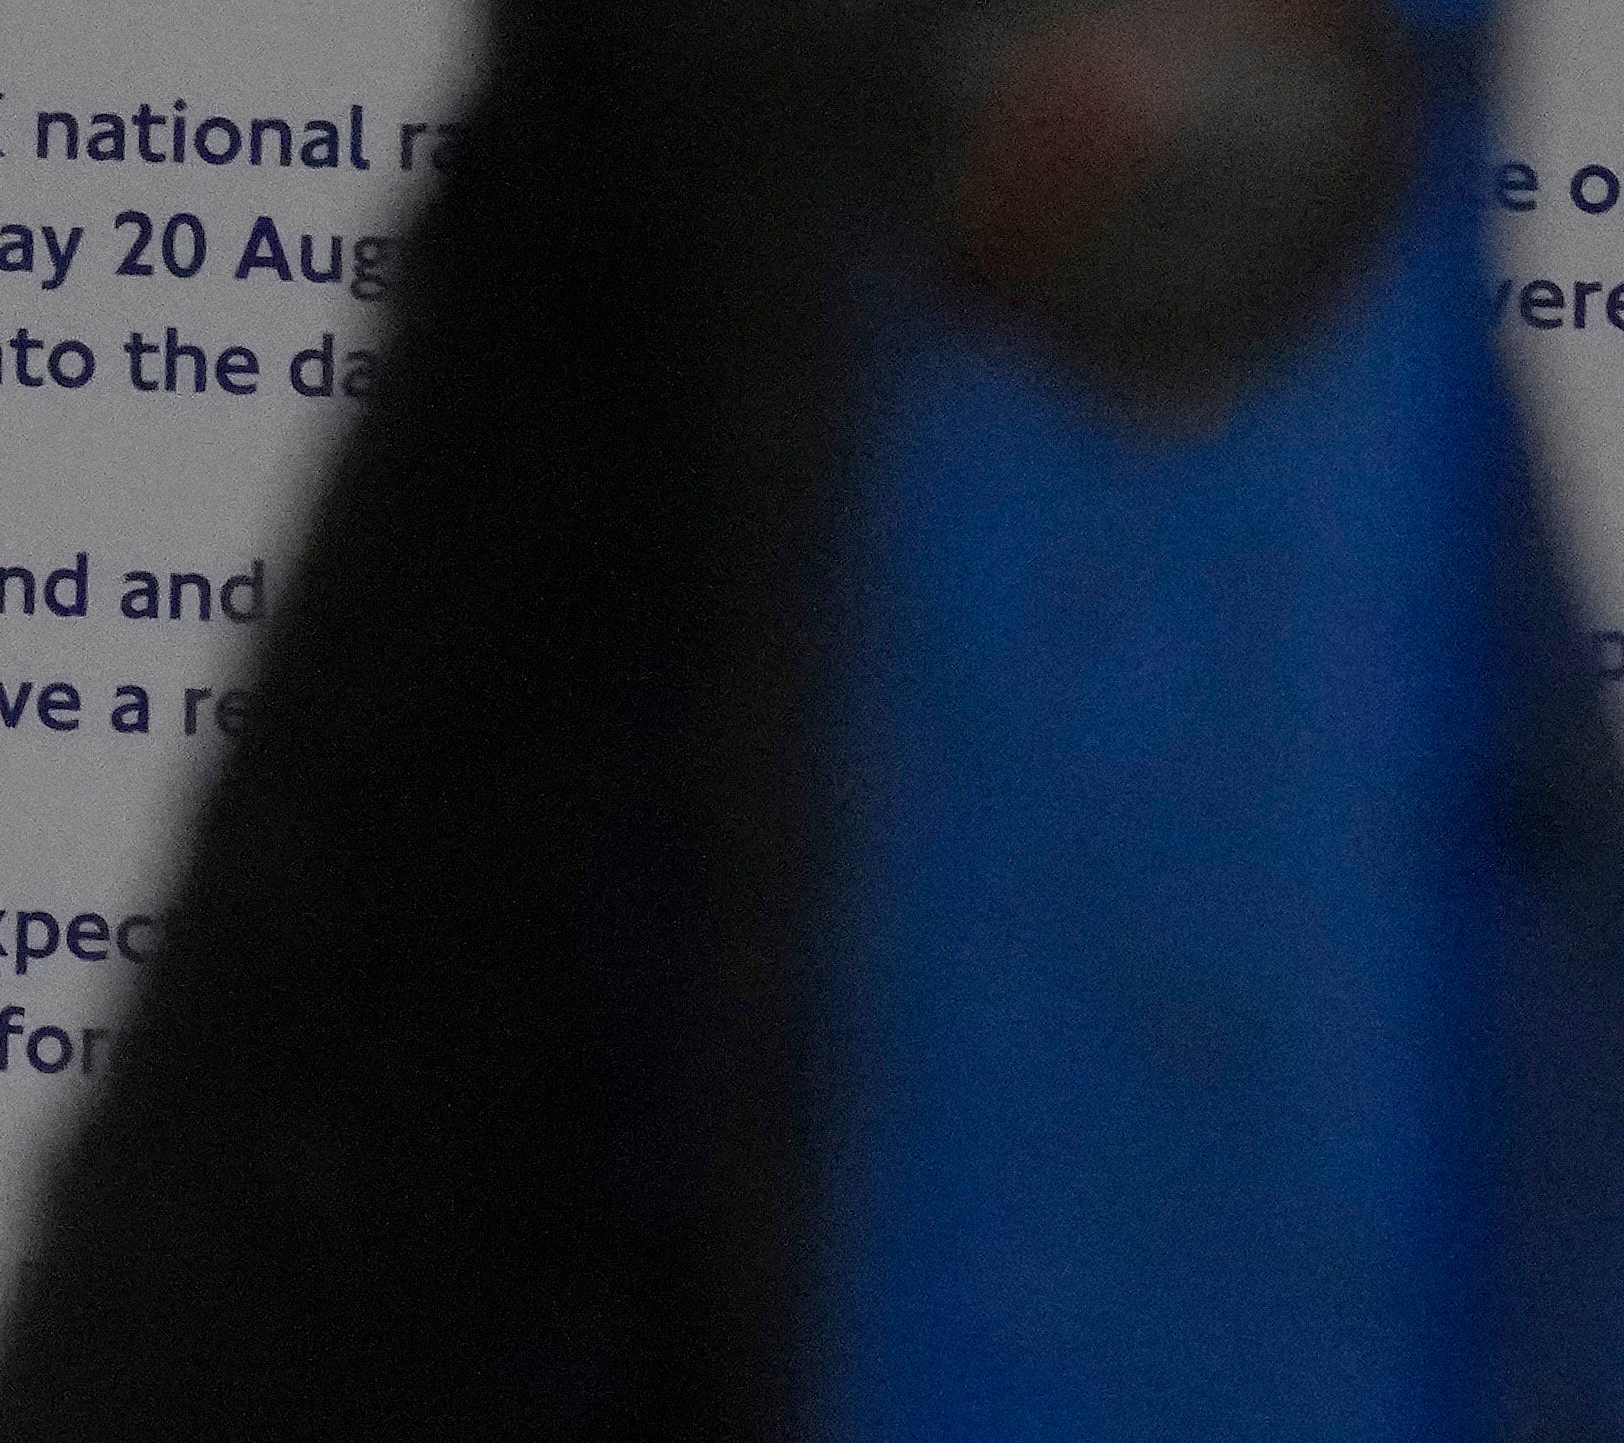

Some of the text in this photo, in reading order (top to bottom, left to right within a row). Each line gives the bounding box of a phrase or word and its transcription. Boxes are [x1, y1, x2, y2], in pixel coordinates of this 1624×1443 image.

[36, 99, 370, 171] national
[114, 209, 207, 279] 20
[123, 327, 260, 396] the
[120, 561, 264, 623] and
[110, 684, 150, 734] a
